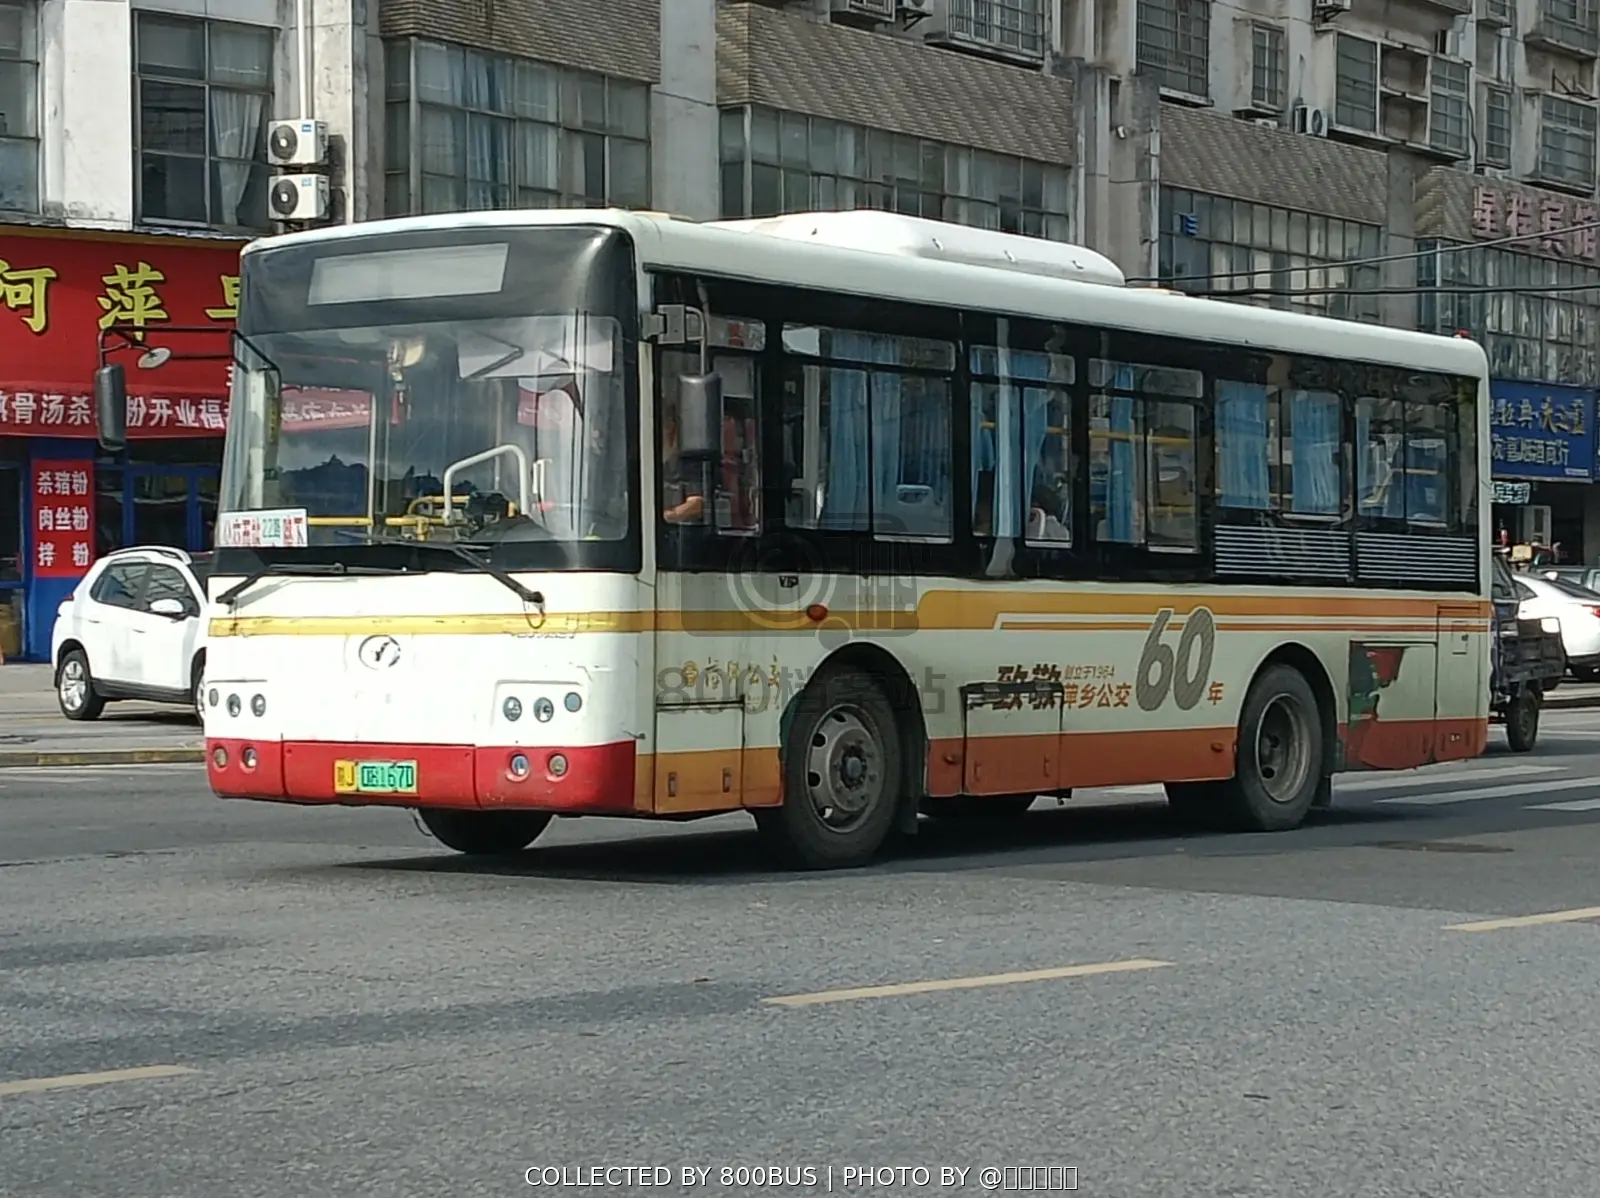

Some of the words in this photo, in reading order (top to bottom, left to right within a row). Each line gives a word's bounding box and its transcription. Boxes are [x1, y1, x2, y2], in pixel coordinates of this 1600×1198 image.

[0, 390, 230, 428] 骨汤杀粉开业福
[37, 470, 88, 495] 杀猪粉
[38, 505, 89, 531] 肉丝粉
[1063, 681, 1132, 709] 萍乡公交
